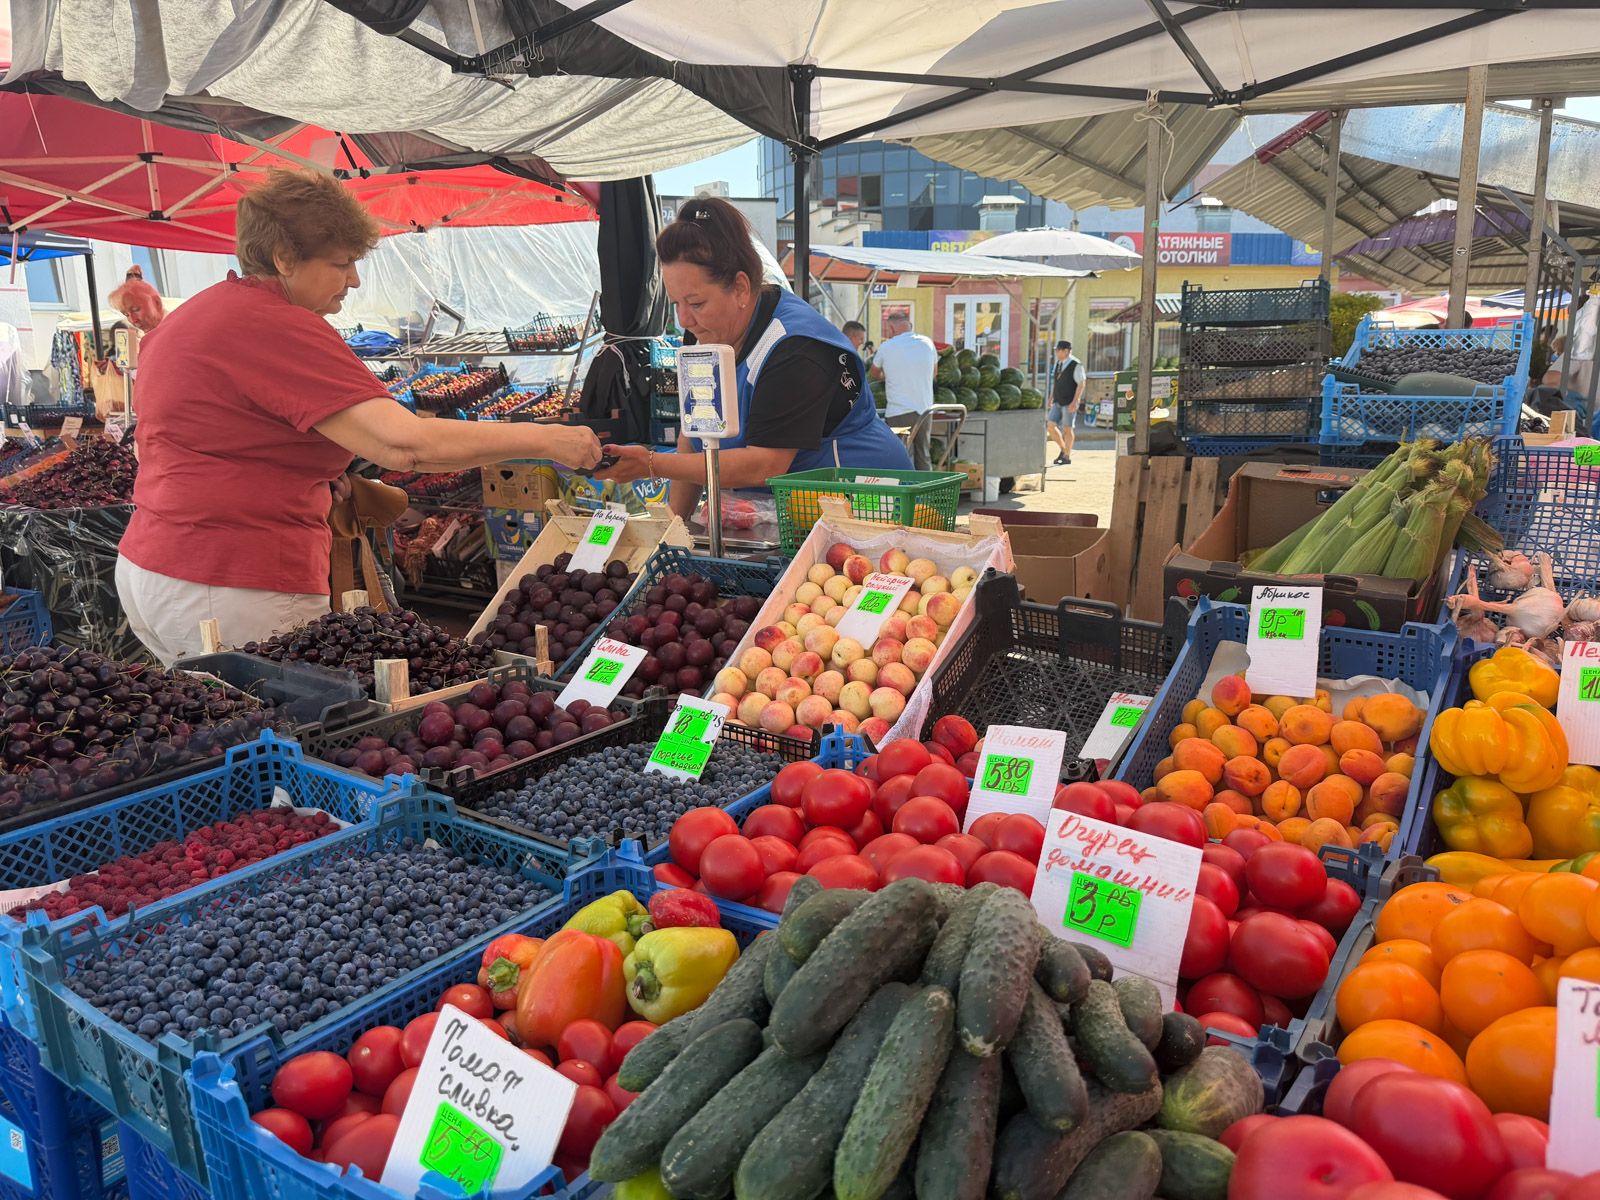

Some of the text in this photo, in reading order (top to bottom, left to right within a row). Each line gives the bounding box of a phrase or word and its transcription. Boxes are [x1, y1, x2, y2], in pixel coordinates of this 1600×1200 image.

[1156, 236, 1224, 249] АТЯЖНЫЕ
[1156, 251, 1218, 264] ОТОЛКИ
[1257, 587, 1311, 602] Абрикос
[1570, 641, 1600, 659] Пе
[1057, 815, 1157, 865] Огурец
[441, 1018, 524, 1094] Томат
[441, 1107, 463, 1129] ЦЕНА
